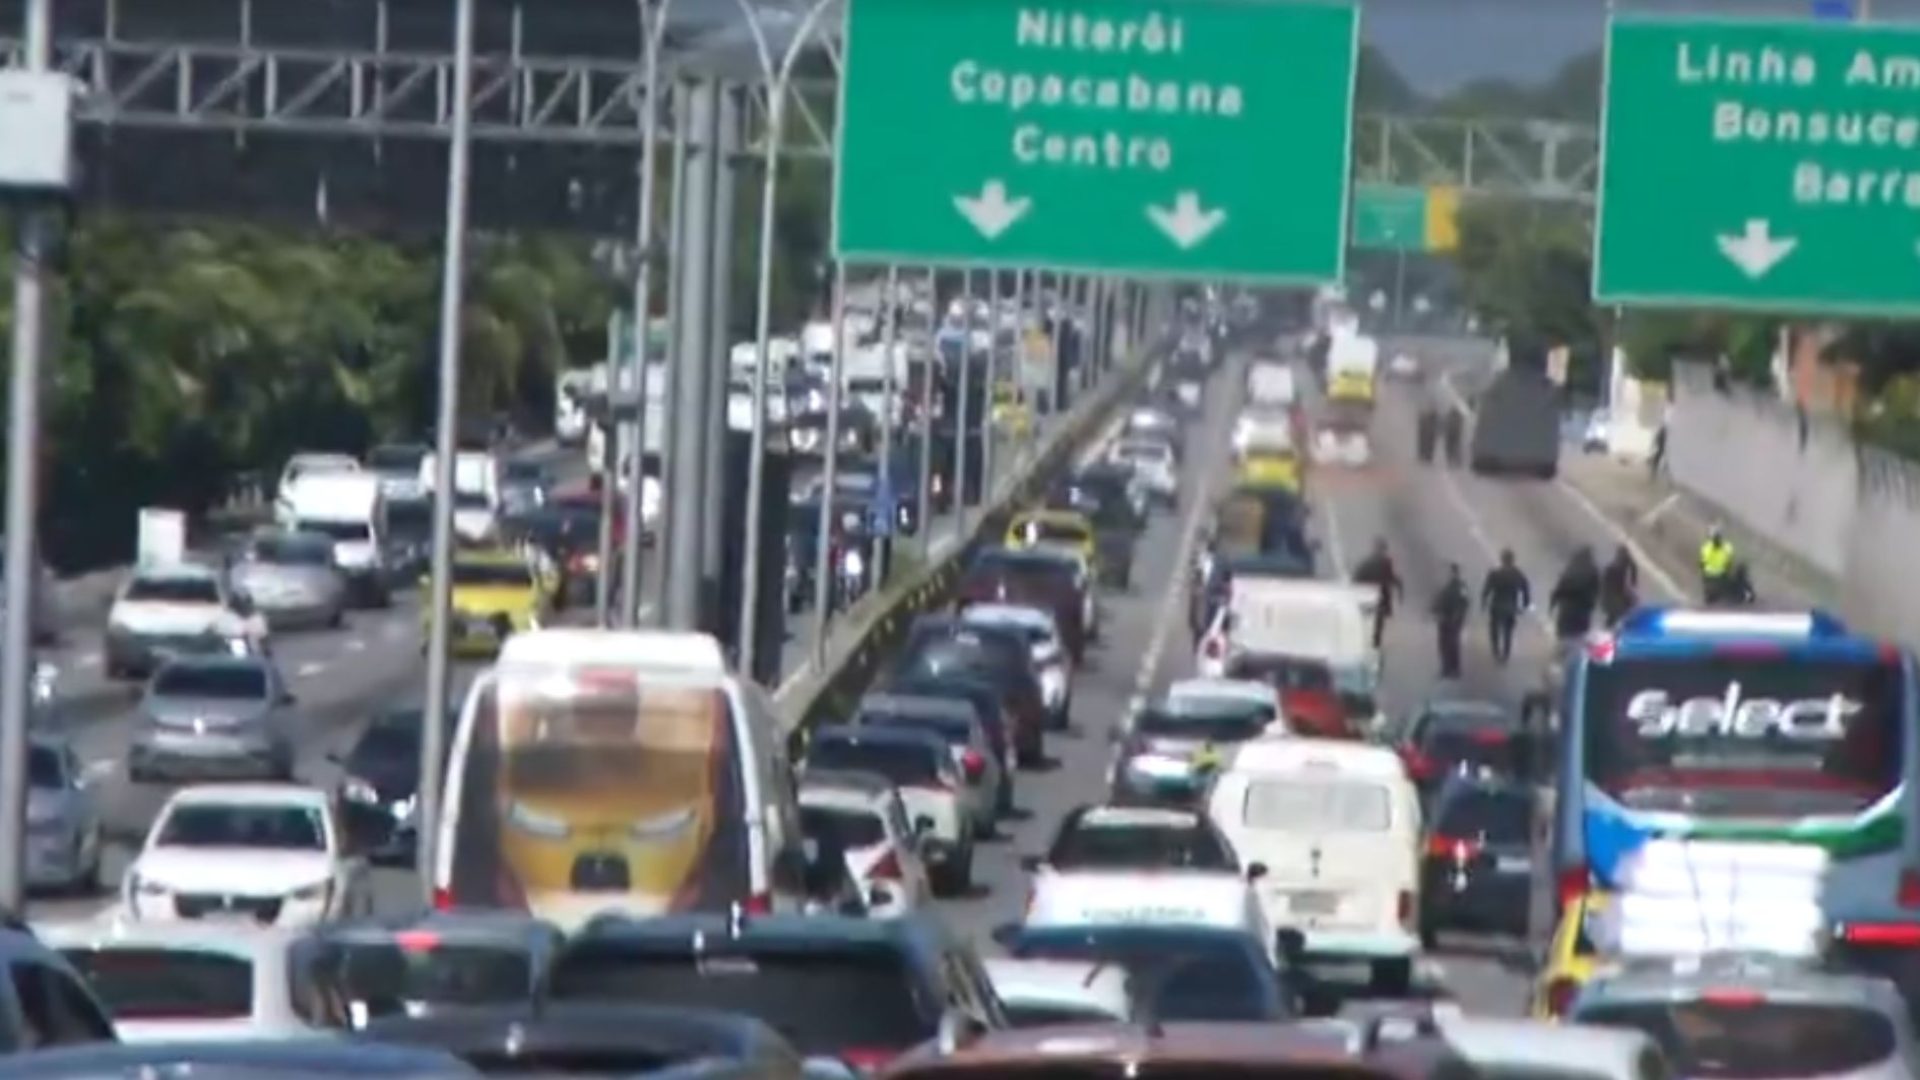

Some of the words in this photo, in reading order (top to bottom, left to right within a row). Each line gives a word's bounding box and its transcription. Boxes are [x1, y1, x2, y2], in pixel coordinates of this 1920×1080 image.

[1677, 42, 1816, 84] Linha
[951, 61, 1242, 115] Copacabana
[1012, 125, 1171, 168] Centro
[1627, 680, 1864, 738] Select
